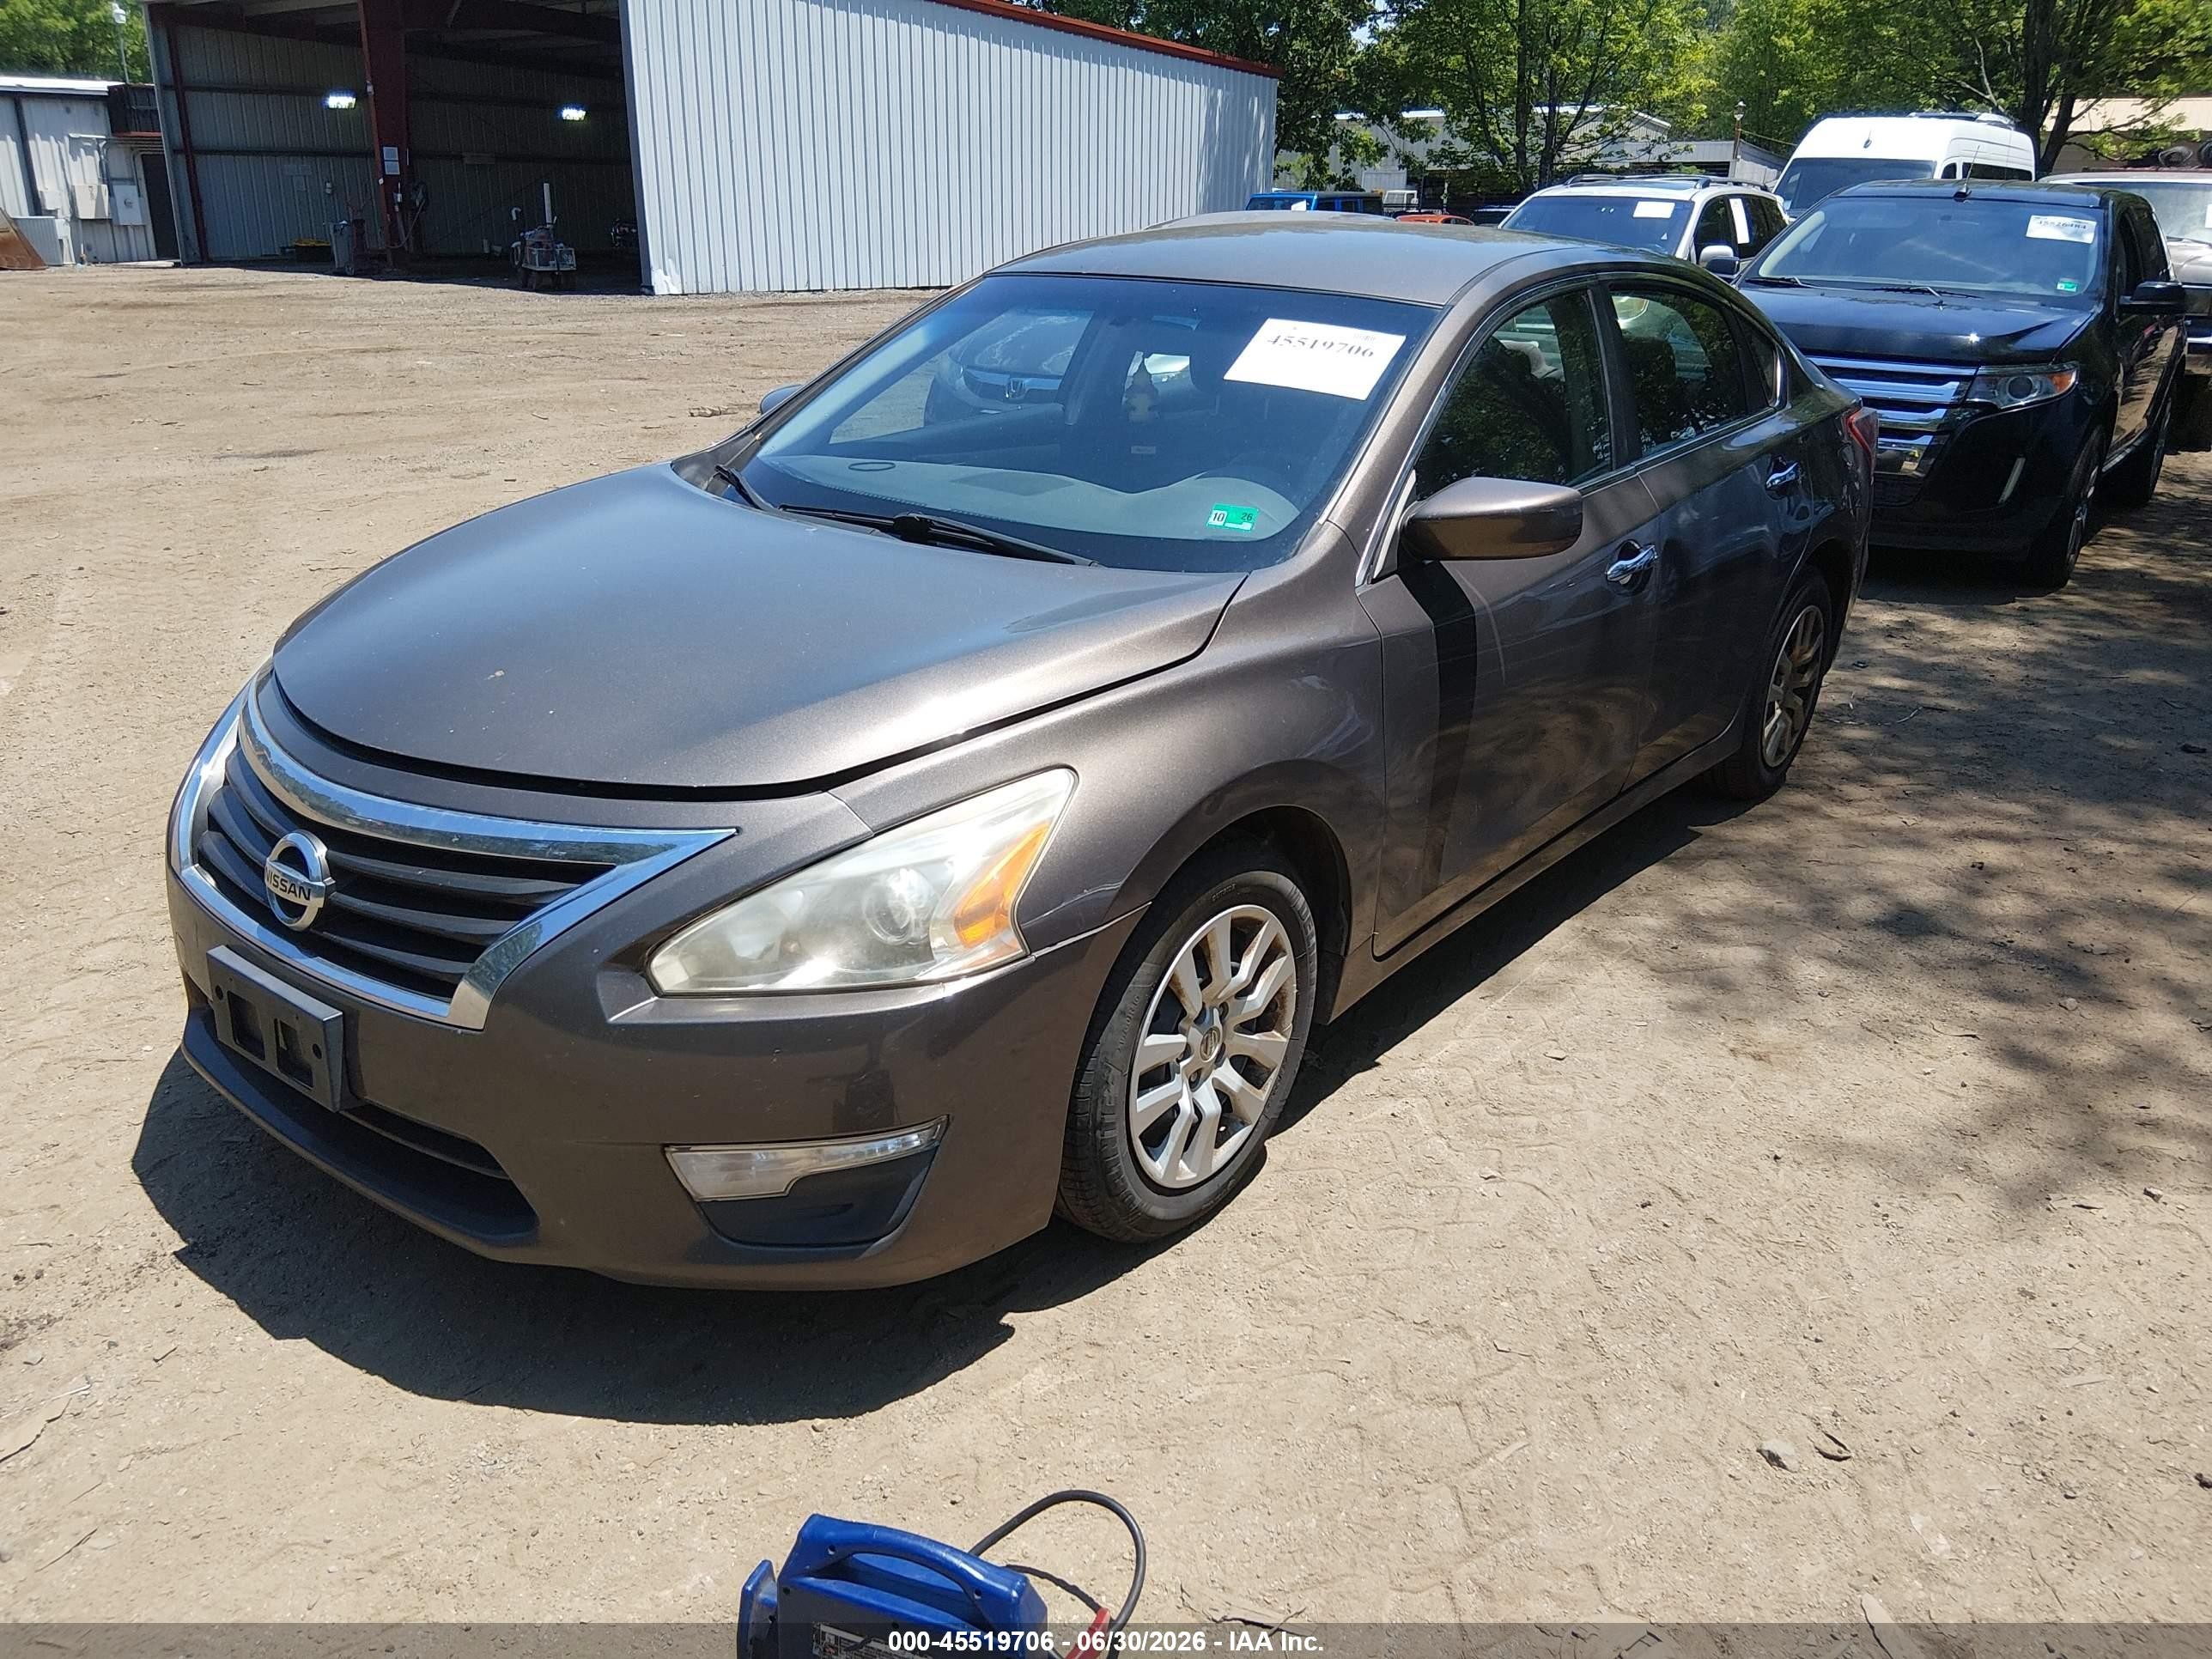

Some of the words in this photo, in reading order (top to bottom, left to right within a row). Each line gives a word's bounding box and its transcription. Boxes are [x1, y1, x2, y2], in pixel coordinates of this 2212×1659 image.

[1267, 335, 1374, 357] 45519706
[1212, 512, 1225, 522] 10
[1240, 512, 1254, 521] 26
[265, 866, 312, 901] NISSAN
